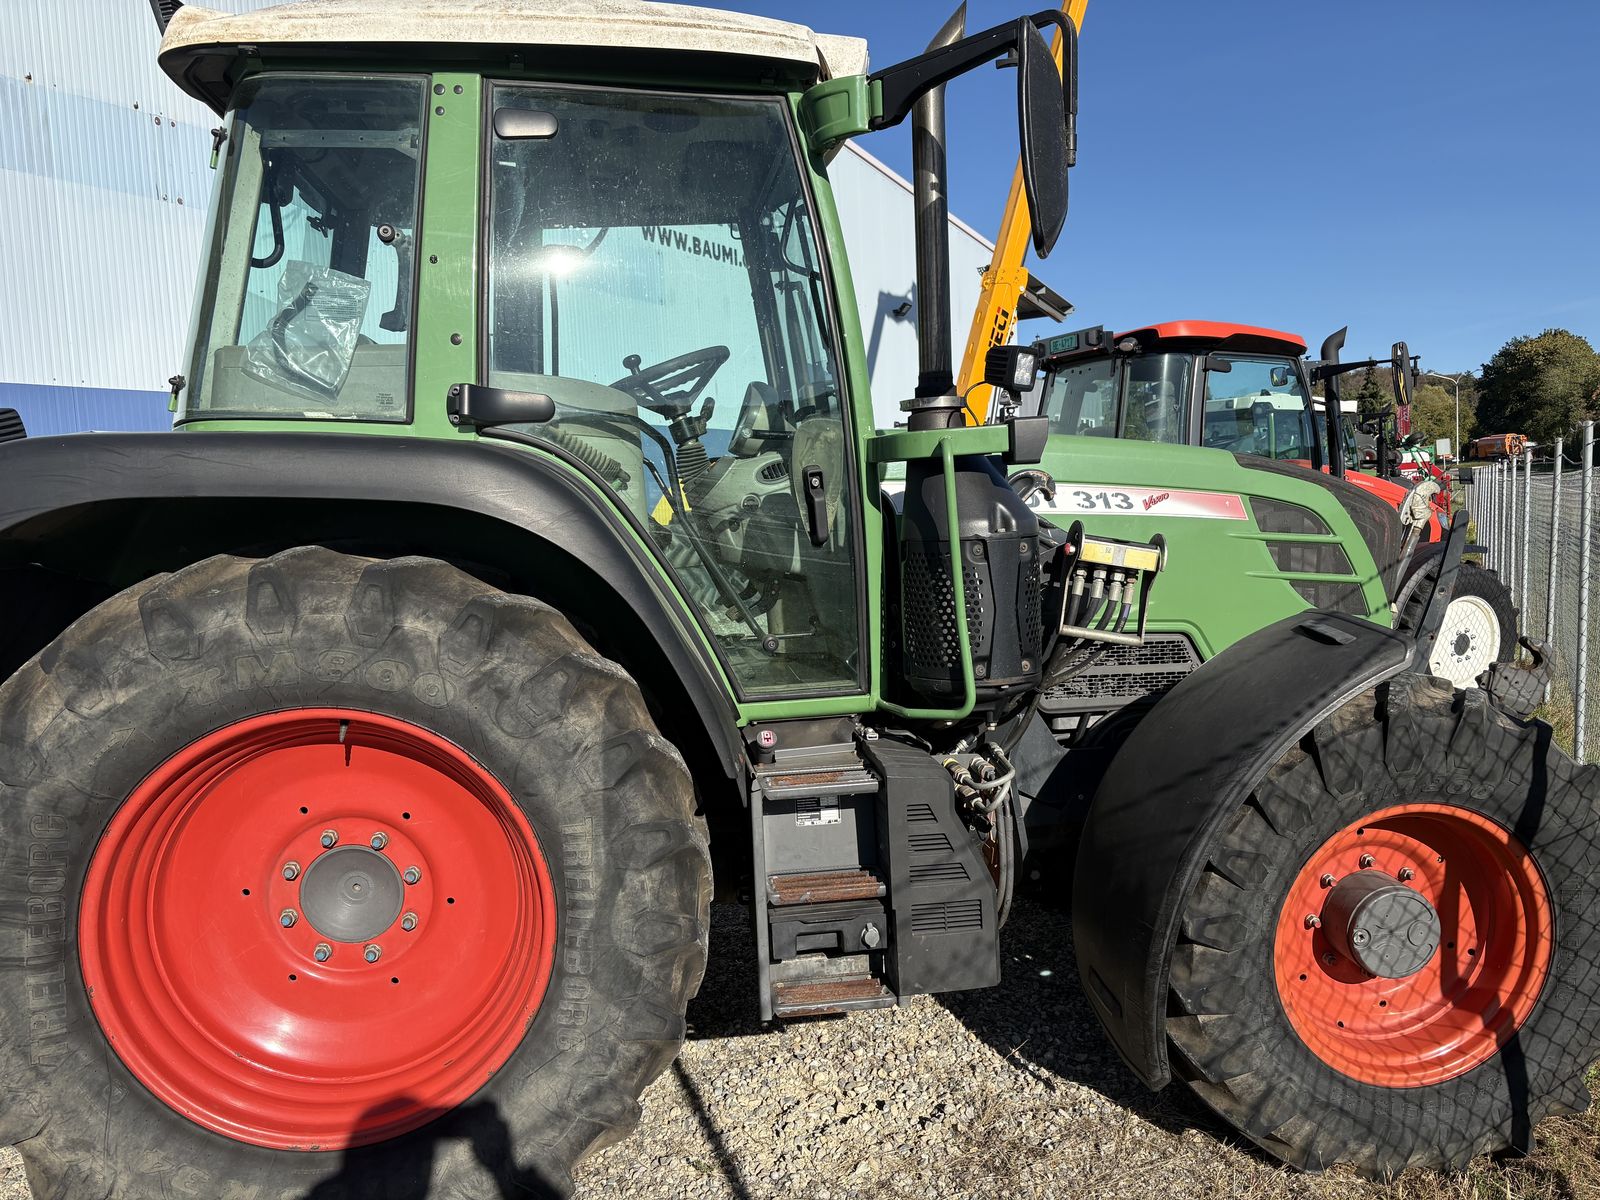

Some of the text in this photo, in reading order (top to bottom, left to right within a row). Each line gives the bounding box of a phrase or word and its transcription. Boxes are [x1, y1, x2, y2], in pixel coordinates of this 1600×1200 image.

[1072, 490, 1134, 510] 313
[25, 814, 70, 1068] TRELLEBORG
[556, 816, 597, 1052] TRELLEBORG
